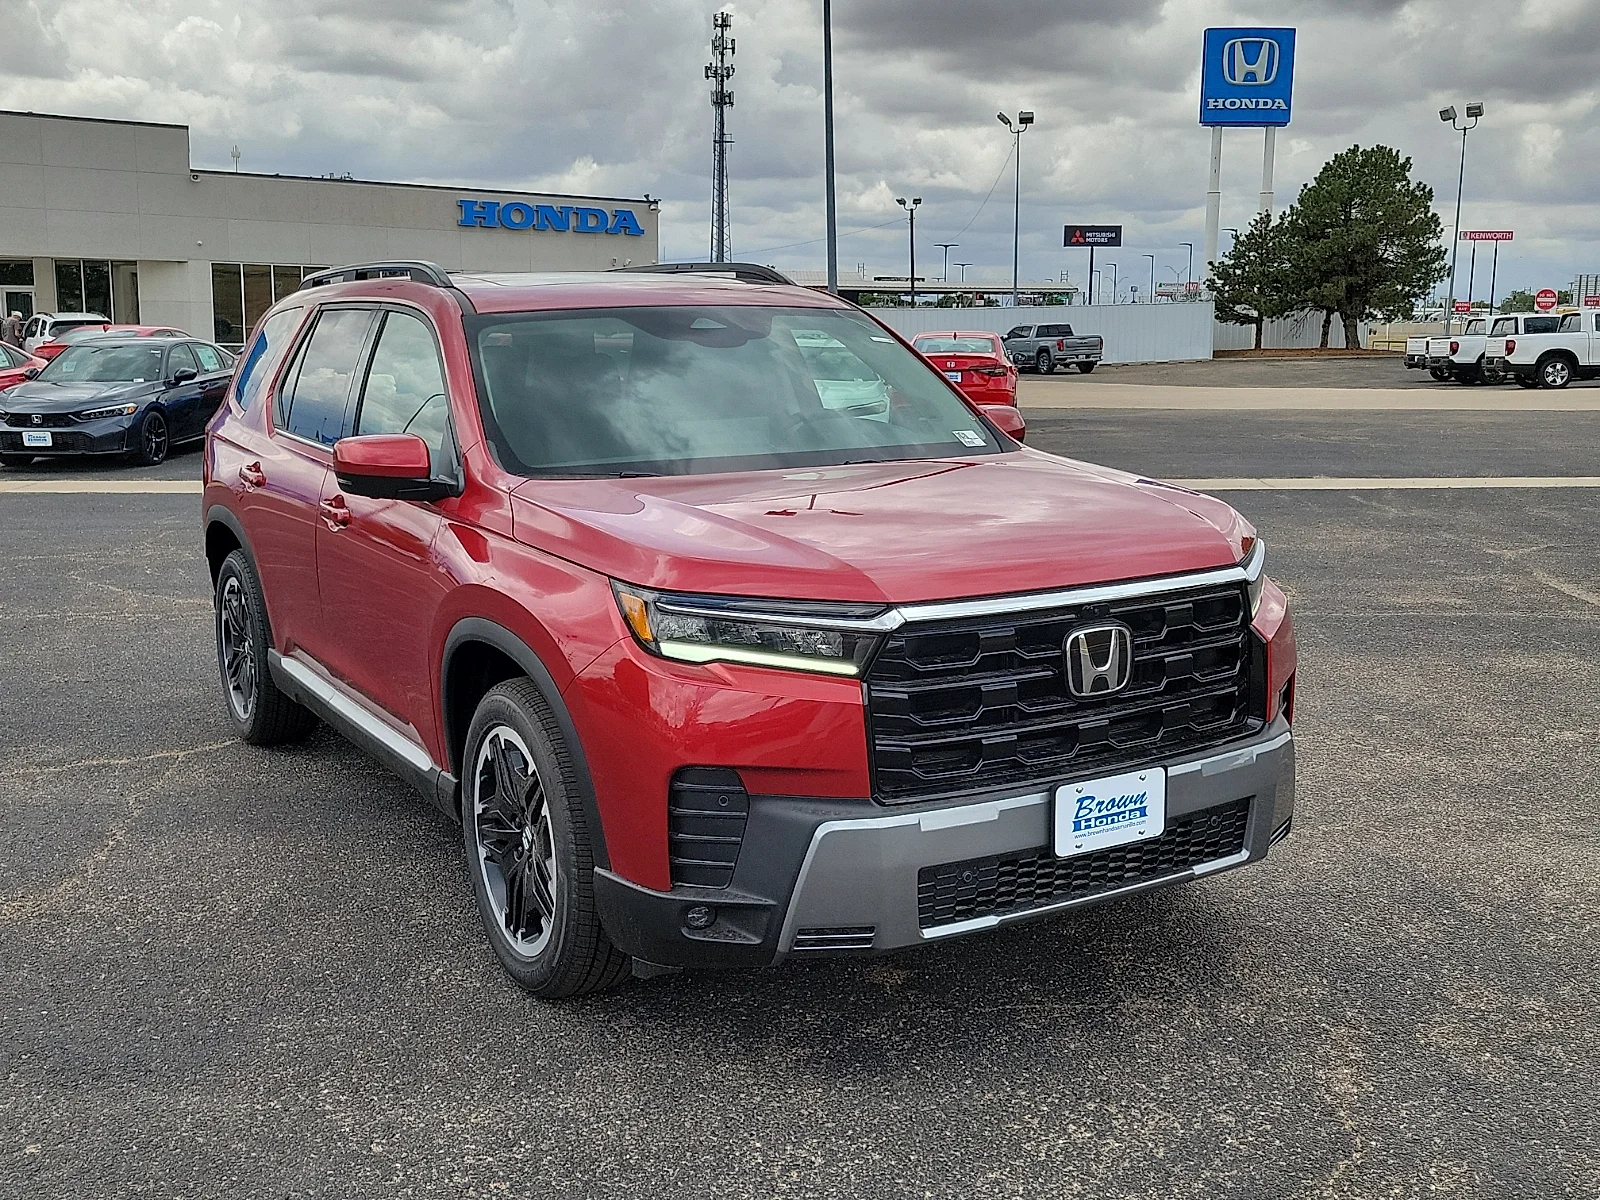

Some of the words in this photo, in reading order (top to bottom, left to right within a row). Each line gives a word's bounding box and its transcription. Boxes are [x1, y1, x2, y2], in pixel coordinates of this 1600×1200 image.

[1206, 98, 1288, 110] HONDA
[458, 199, 645, 236] HONDA
[1470, 232, 1513, 240] KENWORTH
[1074, 791, 1148, 819] Brown
[1081, 810, 1141, 830] Honda
